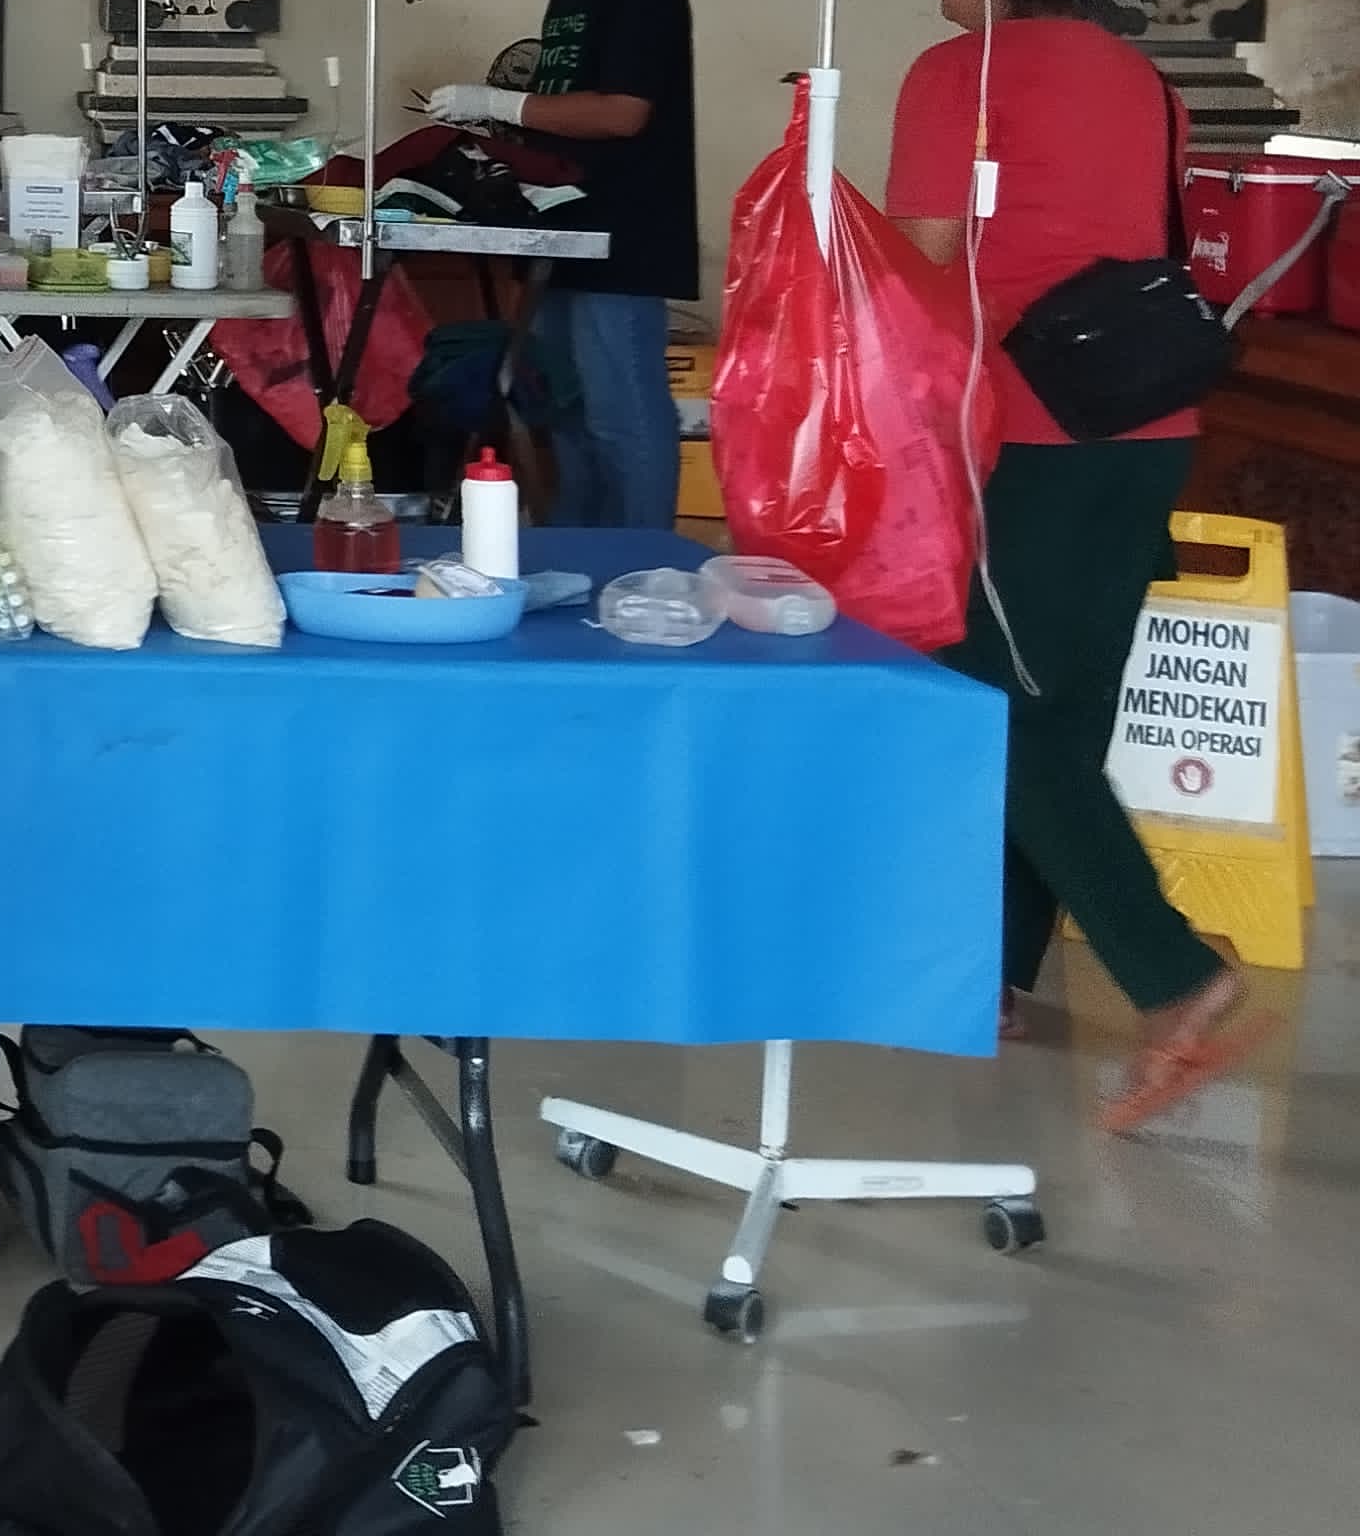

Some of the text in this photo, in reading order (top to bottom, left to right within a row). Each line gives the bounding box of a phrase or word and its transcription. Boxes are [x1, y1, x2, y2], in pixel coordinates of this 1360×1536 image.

[1147, 617, 1250, 651] MOHON
[1144, 653, 1247, 688] JANGAN
[1123, 687, 1267, 727] MENDEKATI
[1125, 723, 1261, 757] MEJA OPERASI
